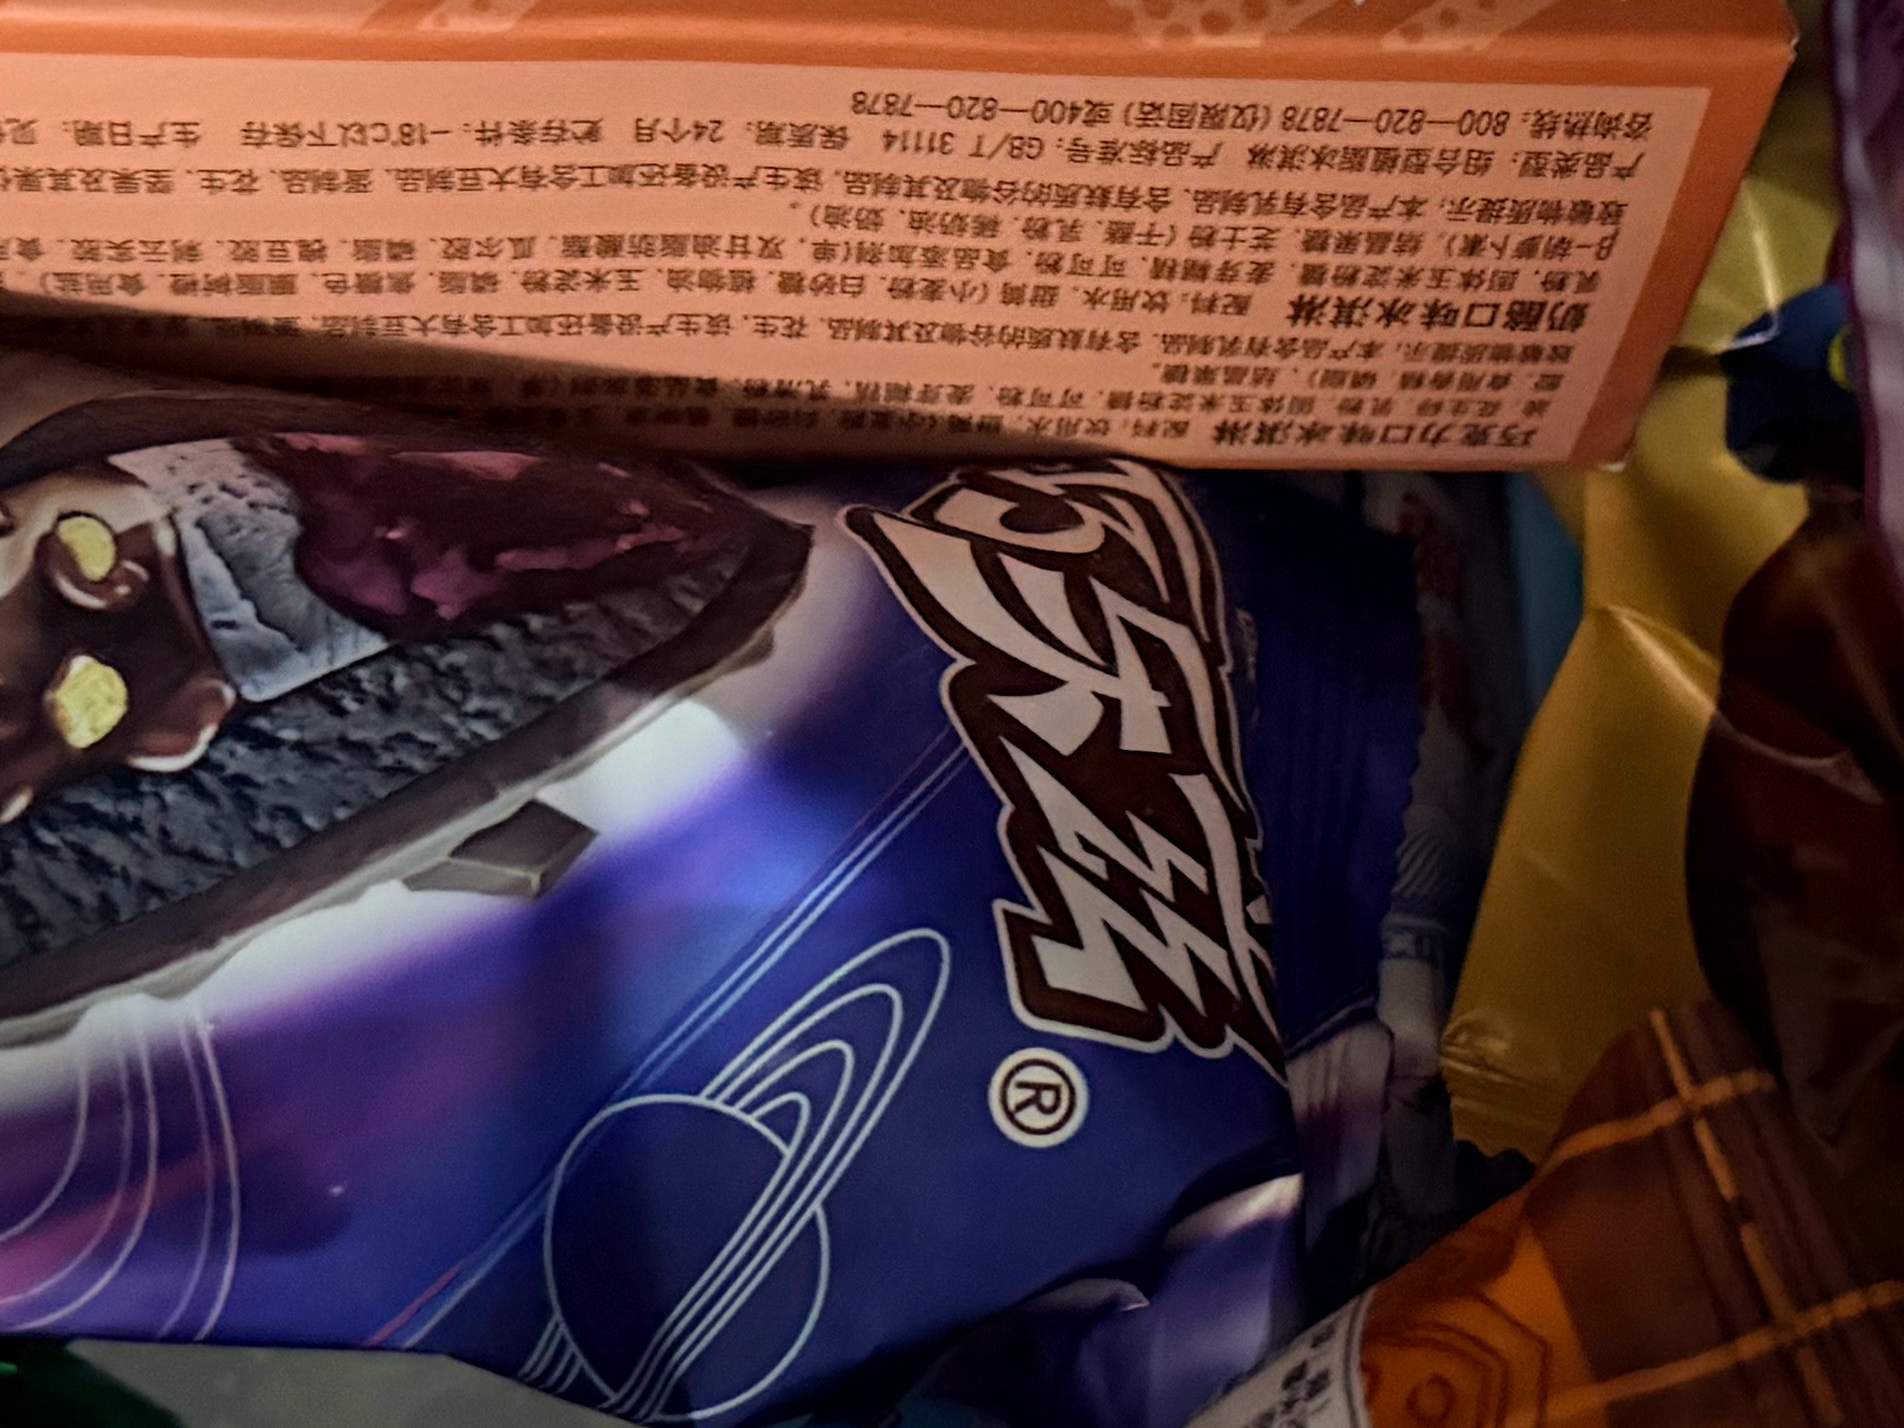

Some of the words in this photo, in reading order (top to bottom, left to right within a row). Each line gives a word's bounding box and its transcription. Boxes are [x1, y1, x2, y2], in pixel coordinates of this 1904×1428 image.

[881, 128, 956, 156] 31114
[1285, 292, 1590, 335] 奶酪口味冰淇淋
[1210, 419, 1540, 452] 巧克力口味冰淇淋
